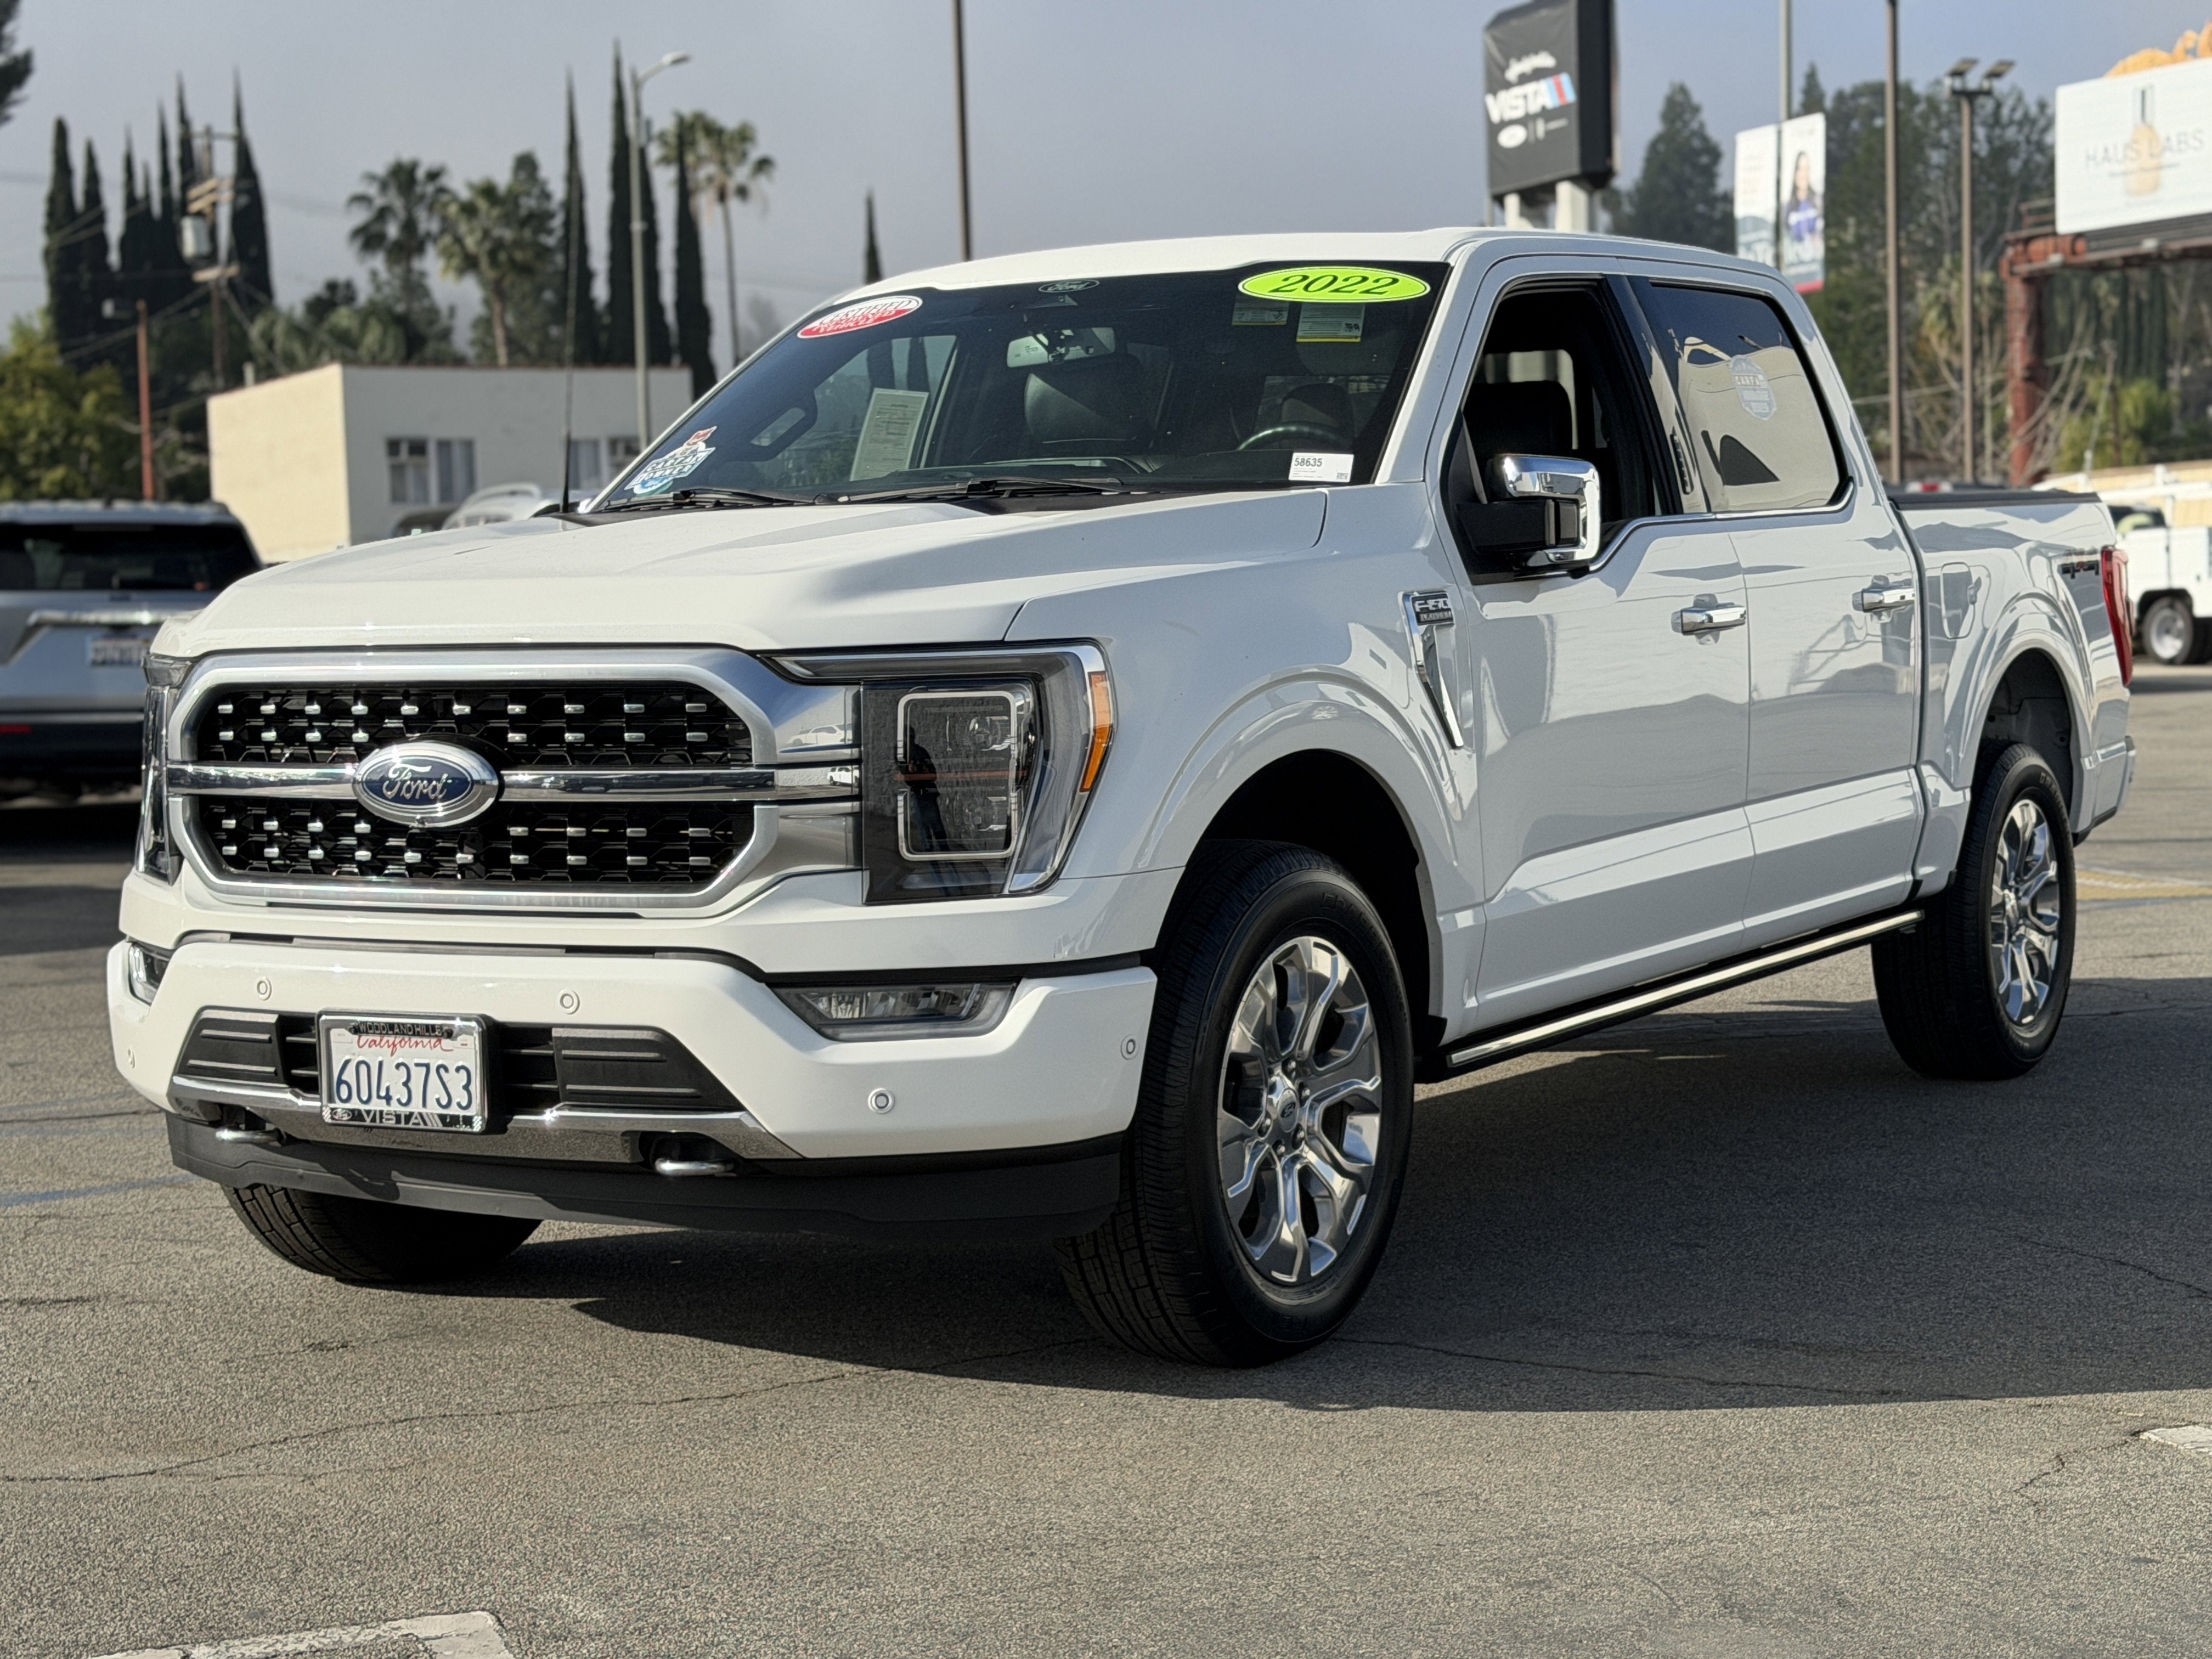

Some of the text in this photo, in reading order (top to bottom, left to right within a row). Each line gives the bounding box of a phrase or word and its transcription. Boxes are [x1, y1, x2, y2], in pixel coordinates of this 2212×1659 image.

[1484, 79, 1553, 124] VISTA
[2085, 130, 2204, 167] HAUS LABS
[1268, 274, 1400, 295] 2022
[819, 300, 912, 325] CERTIFIED
[1294, 458, 1323, 467] 58635
[382, 763, 449, 799] Ford
[359, 1022, 413, 1035] WOODLAND
[415, 1024, 442, 1036] HILLS
[357, 1035, 454, 1057] California
[336, 1057, 473, 1111] 60437S3
[362, 1109, 424, 1126] VISTA
